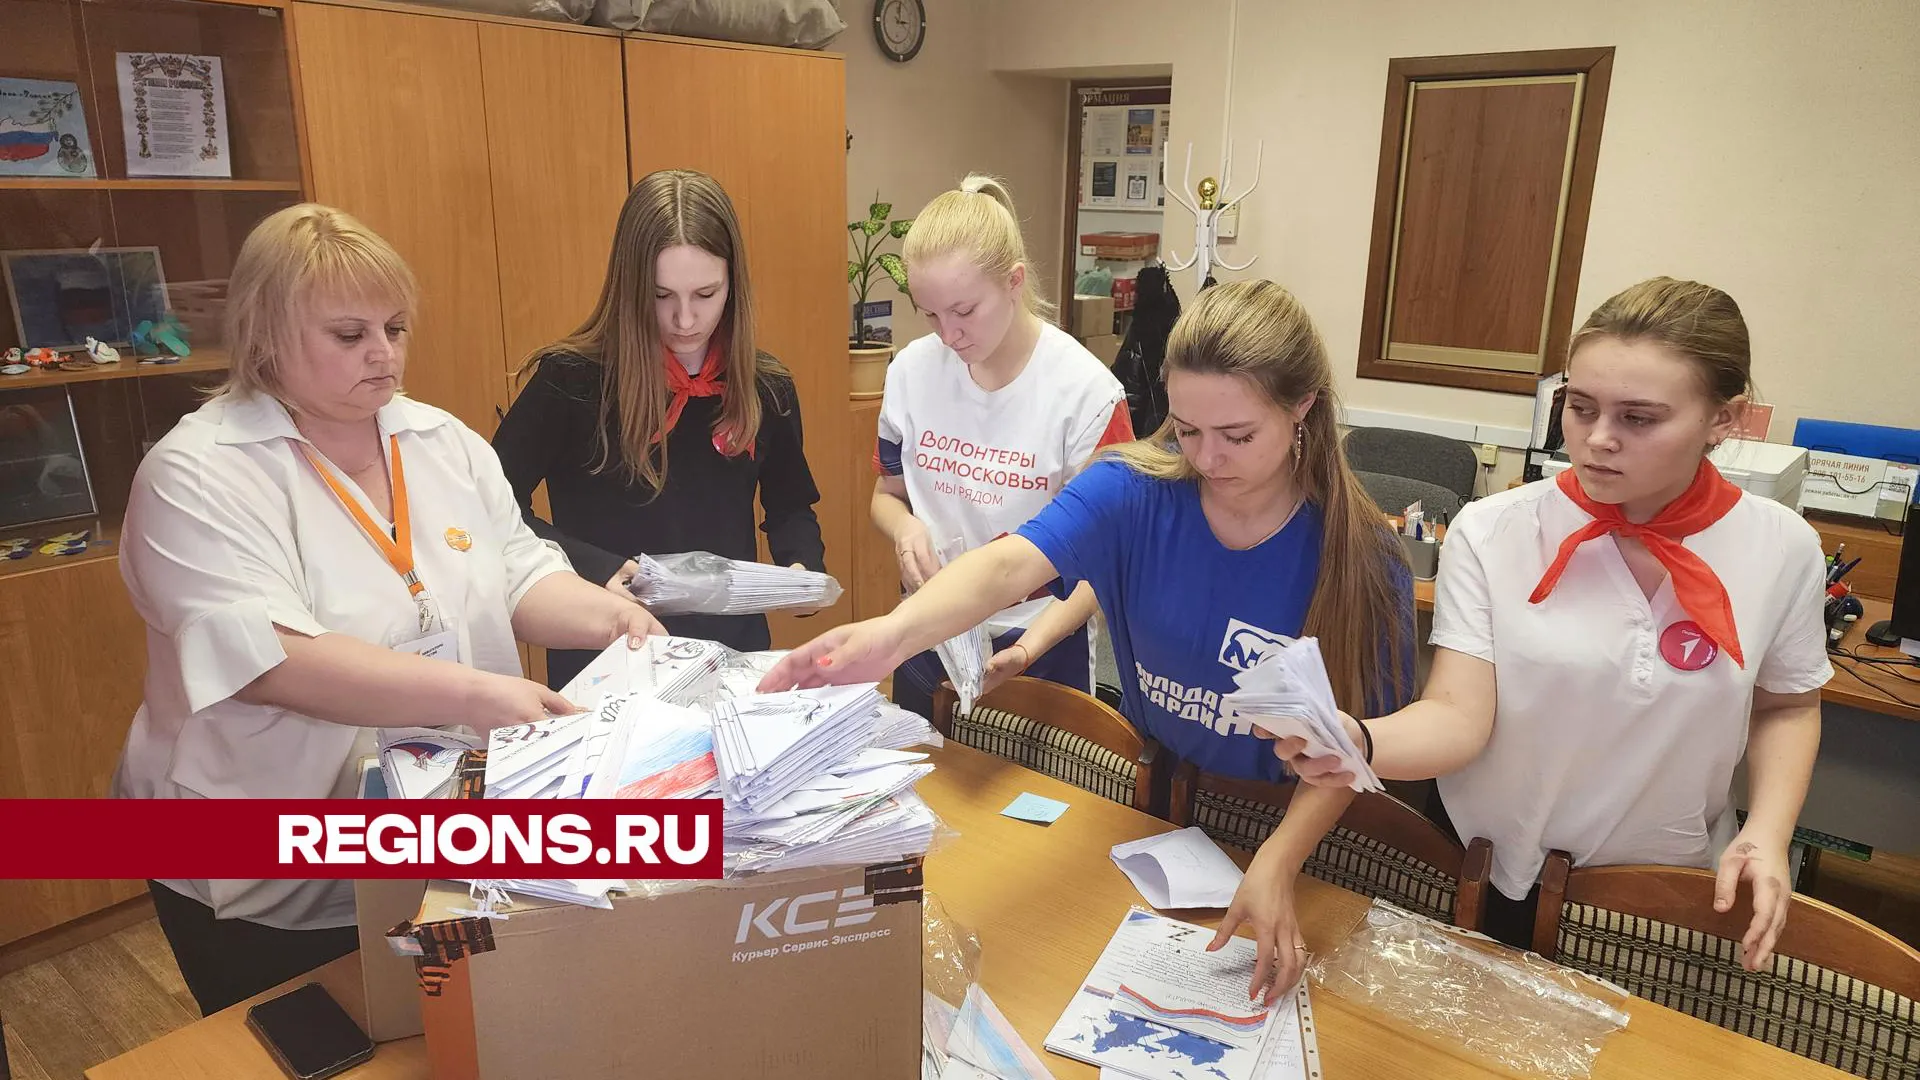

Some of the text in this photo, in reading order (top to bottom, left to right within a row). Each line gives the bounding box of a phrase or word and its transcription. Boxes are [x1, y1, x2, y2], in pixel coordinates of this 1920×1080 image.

[1811, 458, 1870, 473] ОРЯЧАЯ ЛИНИЯ
[934, 481, 1003, 506] МЫ РЯДОМ
[731, 927, 891, 963] Курьер Сервис Экспресс
